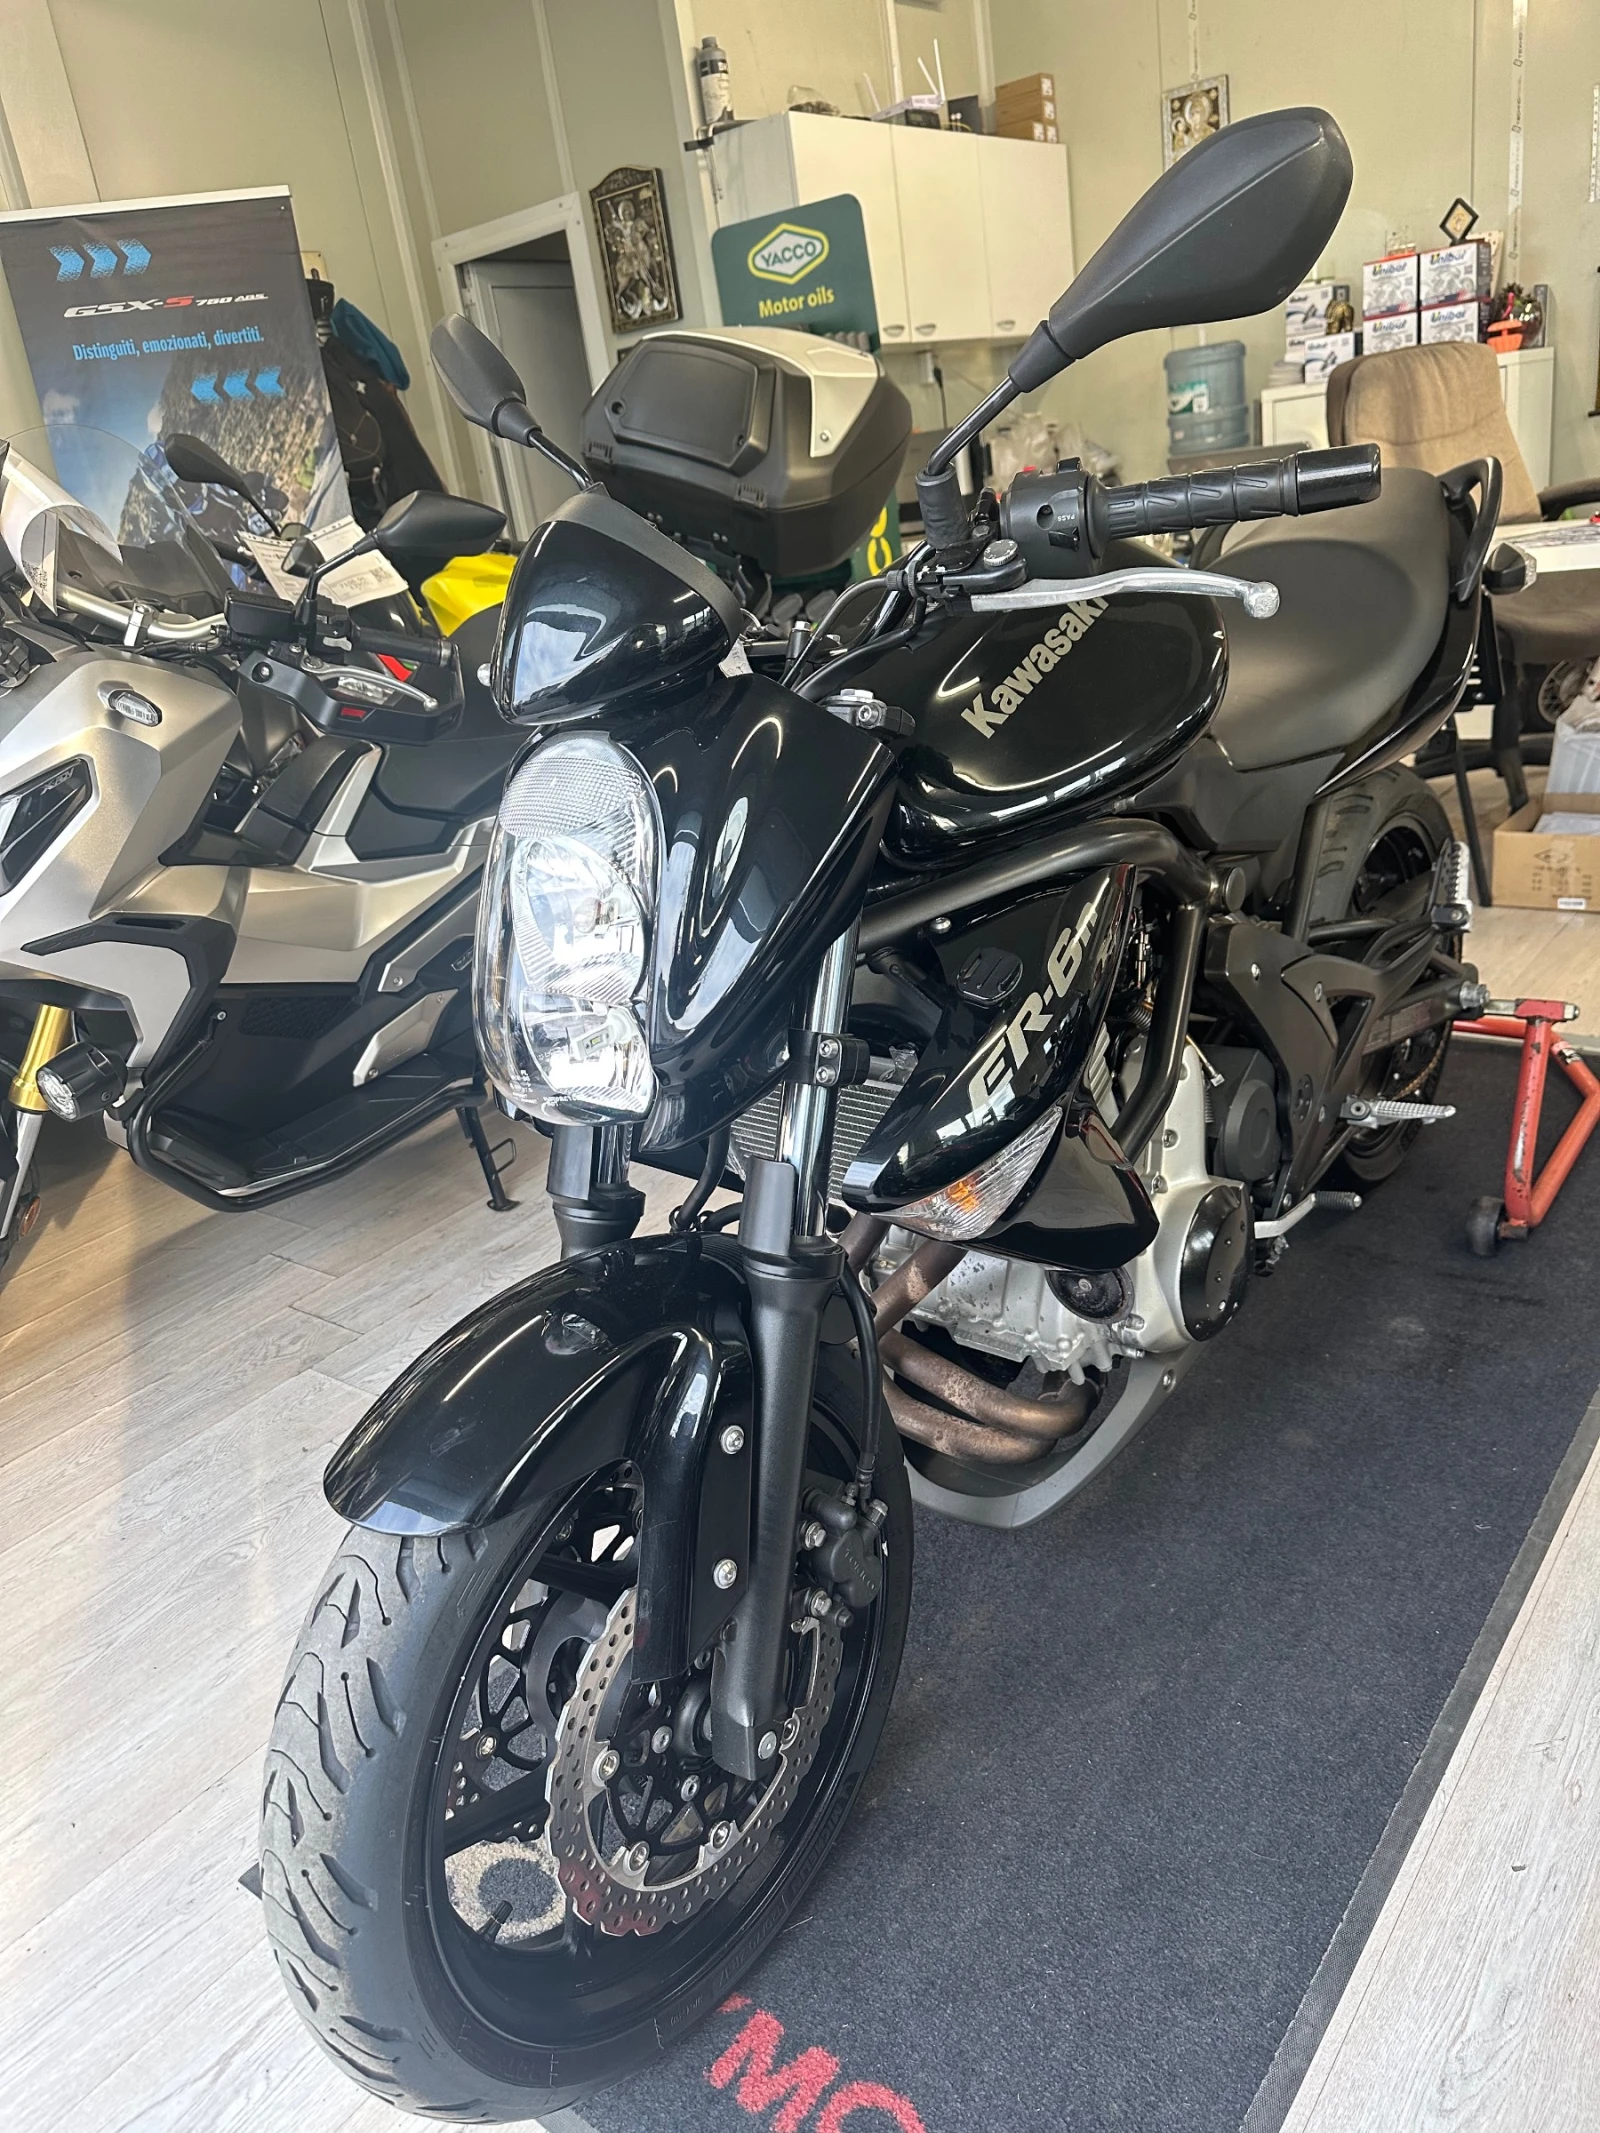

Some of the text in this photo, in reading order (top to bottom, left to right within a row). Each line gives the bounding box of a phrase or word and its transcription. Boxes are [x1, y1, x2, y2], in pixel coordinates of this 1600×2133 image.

[761, 241, 816, 267] YACCO
[63, 296, 194, 318] GSX-S
[758, 285, 835, 318] Motor oils
[72, 326, 265, 360] Distinguiti, emozionati, divertiti.
[1057, 513, 1076, 522] PASS
[968, 901, 1098, 1128] ER-6n
